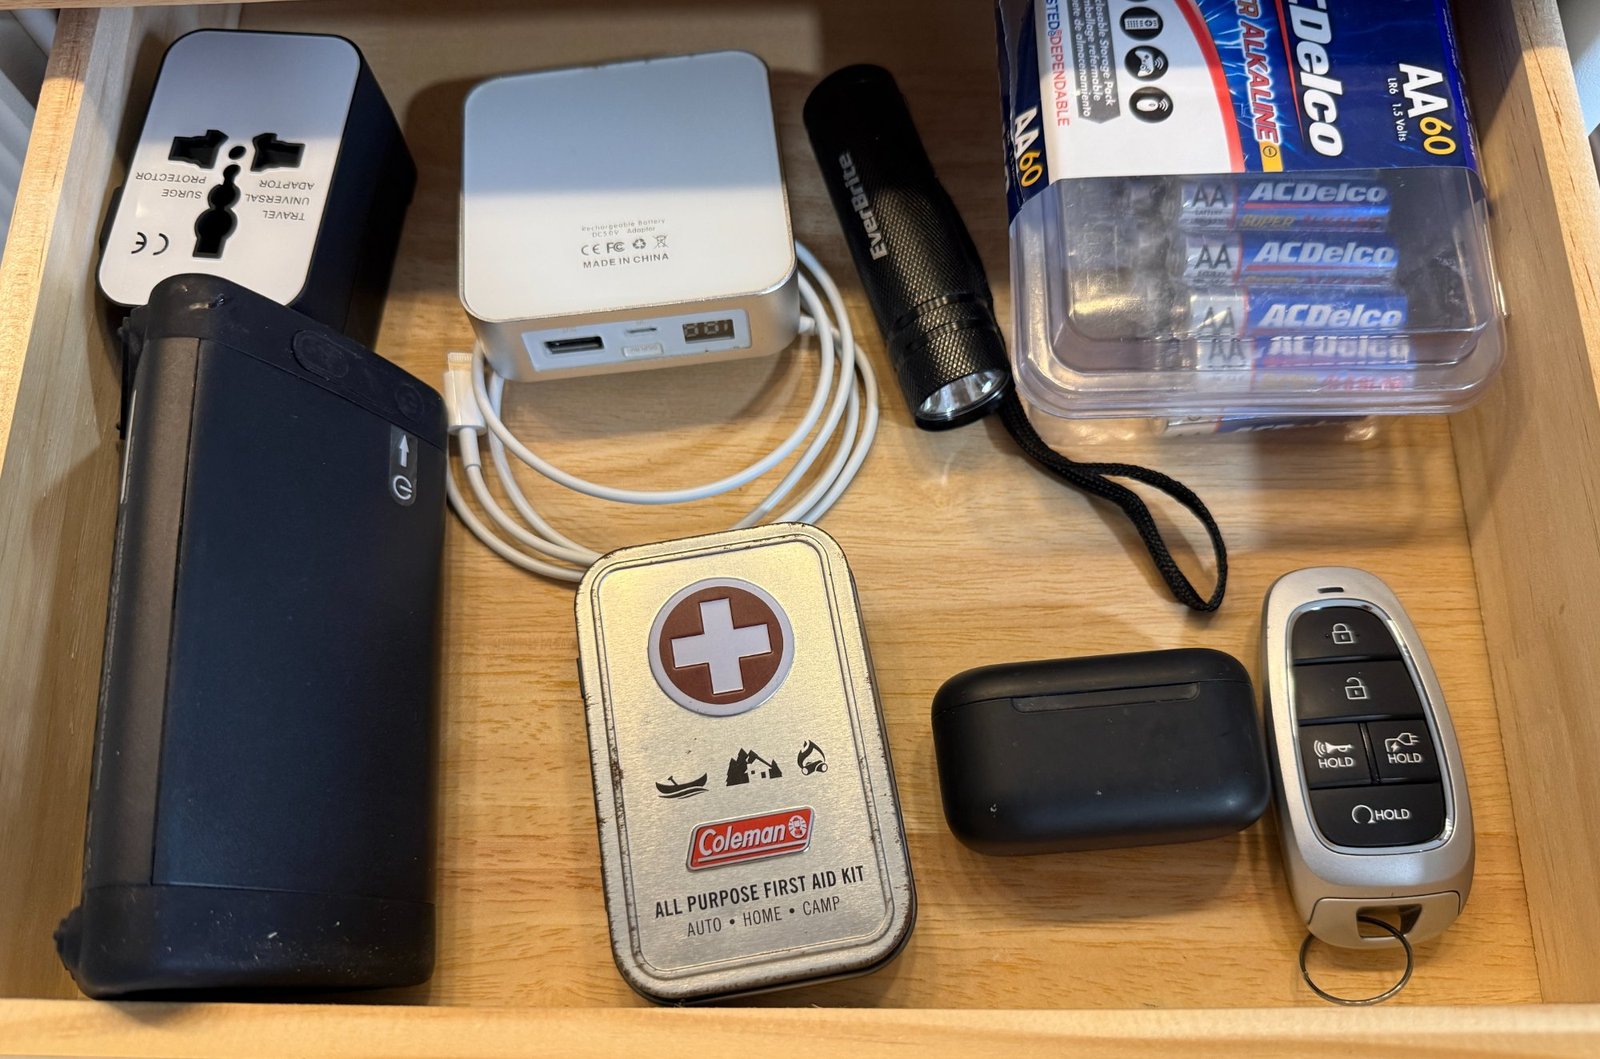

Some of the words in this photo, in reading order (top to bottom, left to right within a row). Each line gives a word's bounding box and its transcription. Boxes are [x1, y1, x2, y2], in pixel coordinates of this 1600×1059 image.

[1074, 19, 1084, 31] de
[1100, 40, 1110, 79] Storage
[1050, 36, 1070, 126] DEPENDABLE
[1076, 33, 1091, 117] almacenamiento
[1089, 45, 1103, 101] refermable
[1240, 20, 1279, 143] ALKALINE
[1288, 0, 1343, 157] Delco
[1388, 77, 1399, 94] LR6
[1104, 81, 1116, 106] Pack
[1392, 103, 1404, 117] 1.5
[1395, 119, 1408, 142] Volts
[135, 171, 207, 184] PROTECTOR
[259, 179, 315, 190] ADAPTOR
[161, 188, 203, 199] SURGE
[245, 193, 310, 205] UNIVERSAL
[839, 150, 888, 260] EverBrite
[1191, 184, 1228, 208] AA
[1248, 182, 1388, 202] ACDelco
[262, 210, 305, 221] TRAVEL
[583, 258, 616, 269] MADE
[619, 257, 630, 265] IN
[633, 253, 669, 264] CHINA
[1194, 244, 1232, 269] AA
[1252, 241, 1396, 263] ACDelco
[1199, 306, 1235, 335] AA
[1257, 303, 1403, 328] ACDelco
[1318, 756, 1355, 769] HOLD
[1387, 752, 1422, 764] HOLD
[1375, 808, 1410, 820] HOLD
[699, 822, 786, 857] Coleman
[655, 898, 683, 919] ALL
[687, 884, 760, 913] PURPOSE
[763, 875, 806, 899] FIRST
[812, 870, 837, 890] AID
[841, 865, 865, 884] KIT
[687, 916, 722, 938] AUTO
[742, 906, 783, 927] HOME
[802, 895, 840, 916] CAMP
